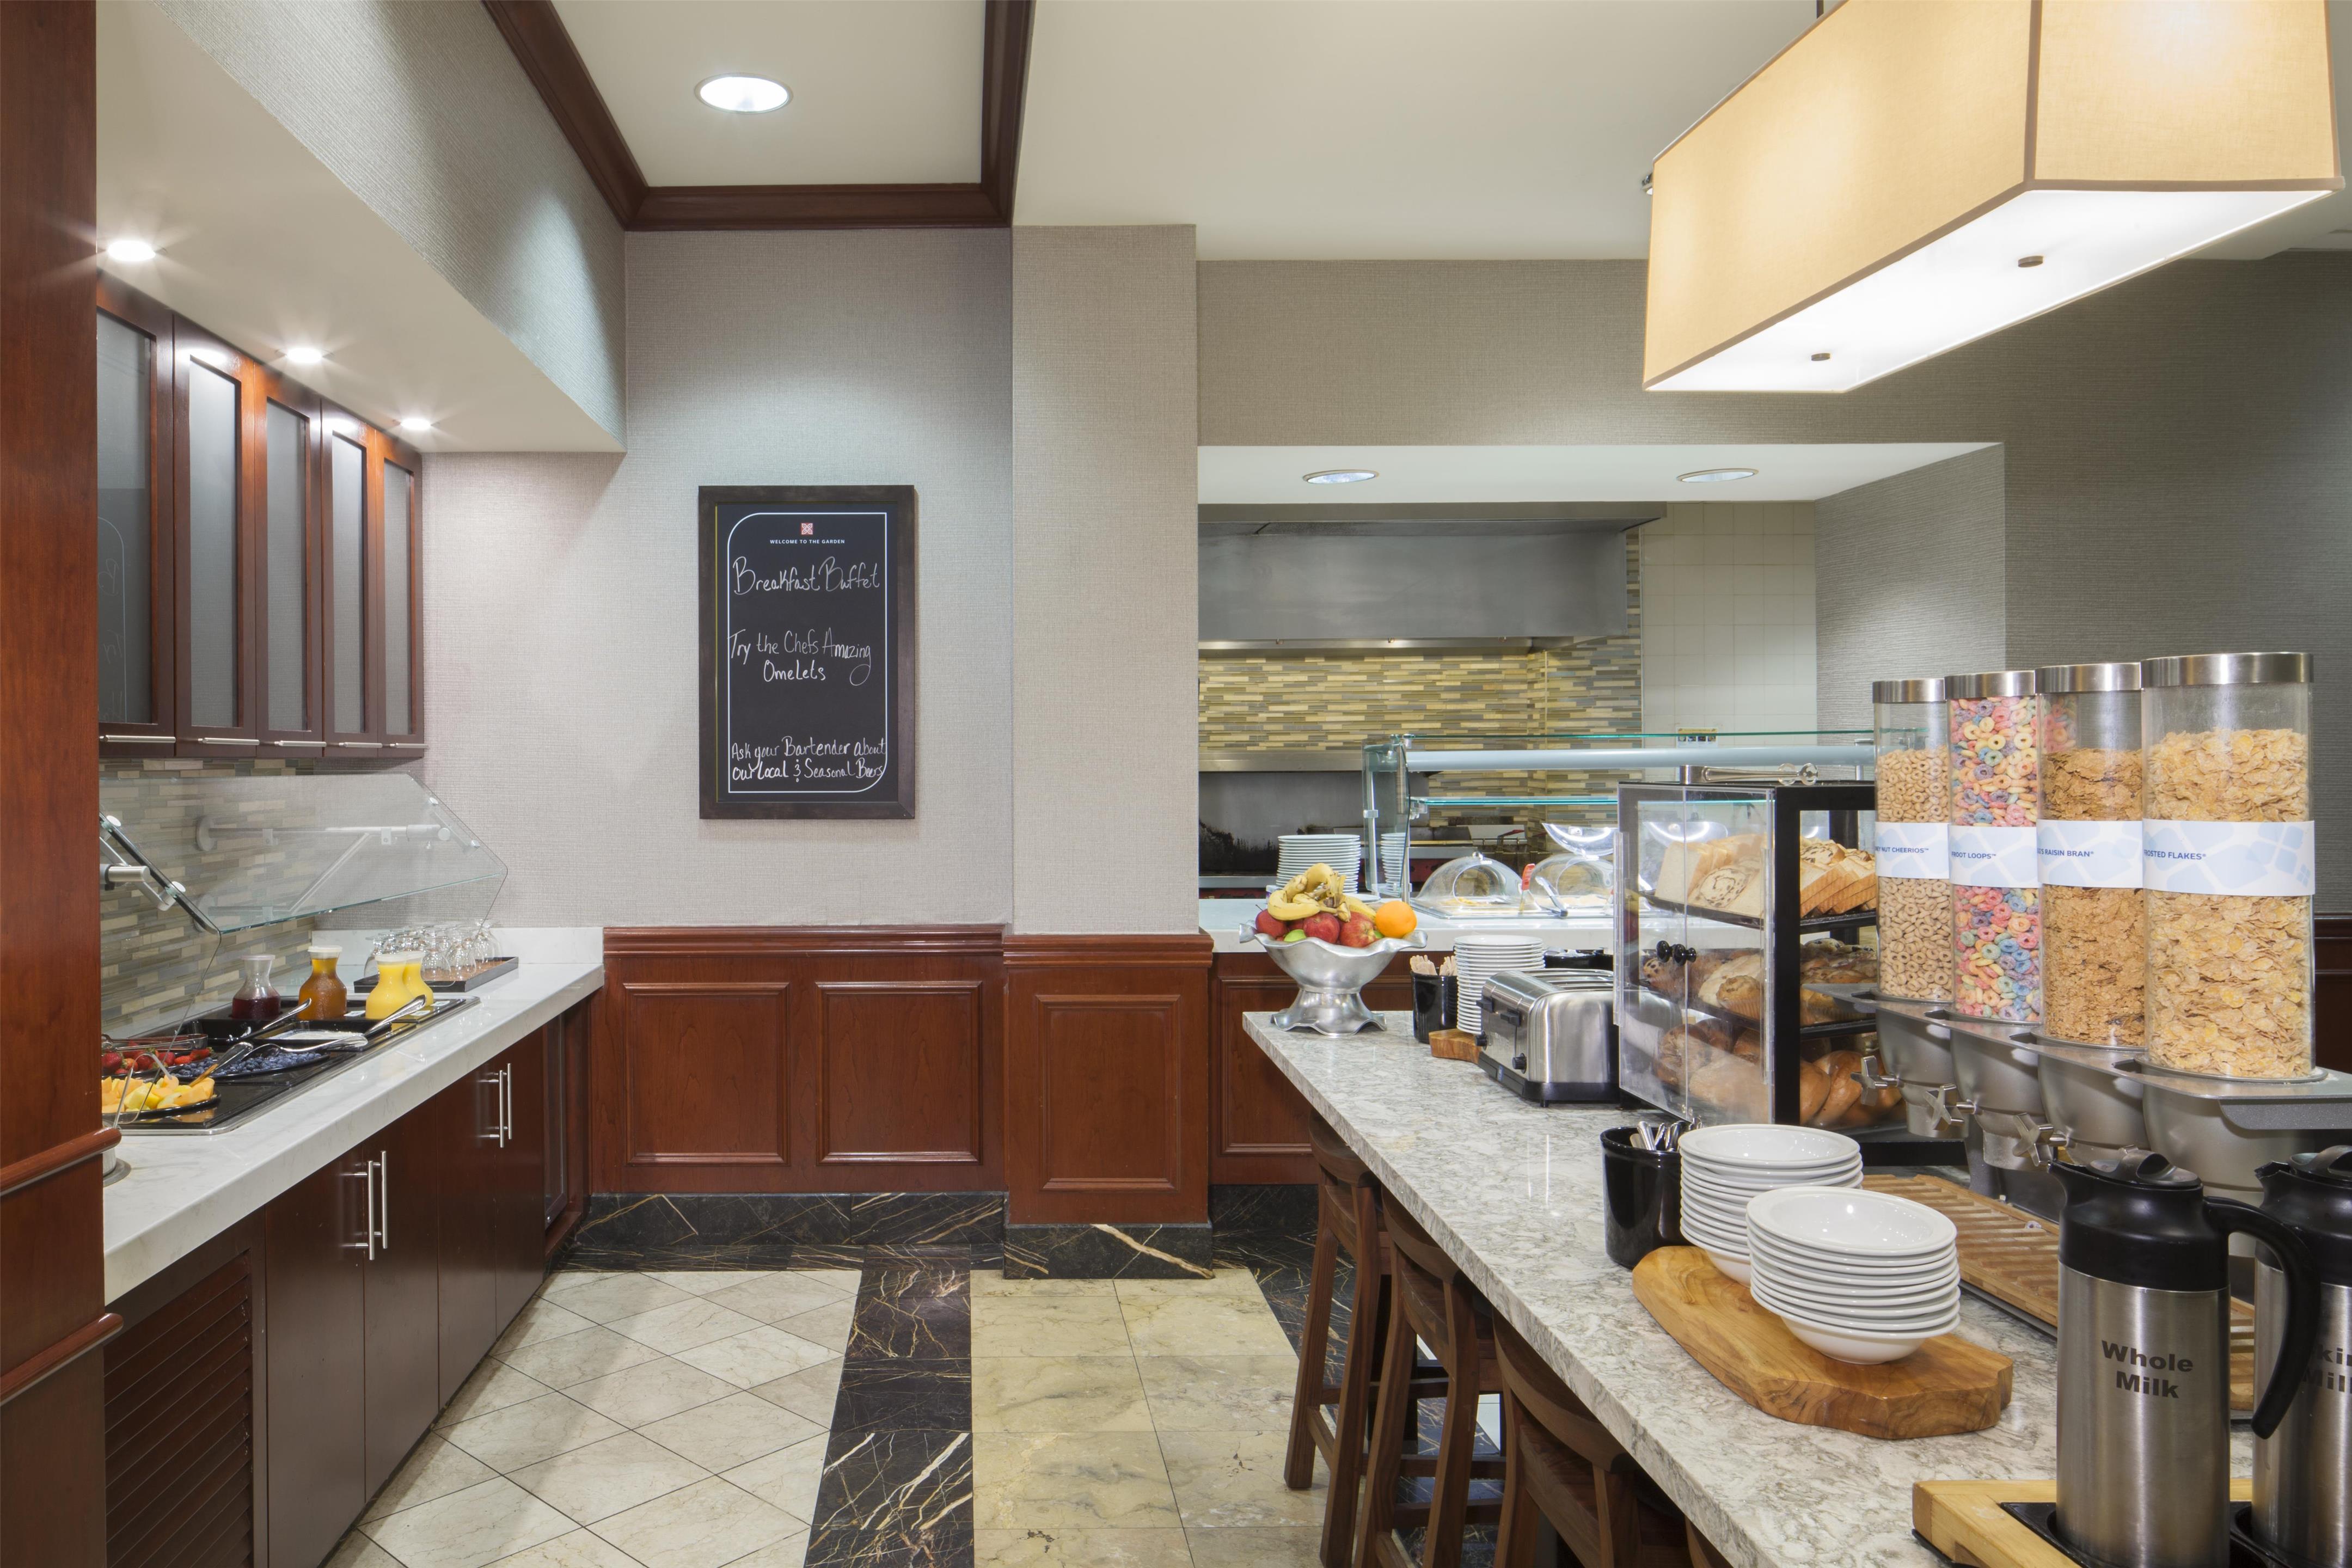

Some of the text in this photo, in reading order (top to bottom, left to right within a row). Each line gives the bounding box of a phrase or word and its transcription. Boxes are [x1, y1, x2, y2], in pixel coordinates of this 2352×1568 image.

[732, 556, 880, 596] Breakfast Buffet
[727, 628, 751, 665] Try
[756, 632, 780, 654] the
[731, 736, 886, 771] Ask your Bartender about
[804, 757, 856, 779] Seasonal
[855, 757, 883, 779] Beers
[2143, 849, 2166, 858] FROSTED
[2102, 1339, 2193, 1373] Whole
[2317, 1345, 2352, 1367] ki
[2116, 1370, 2179, 1399] Milk
